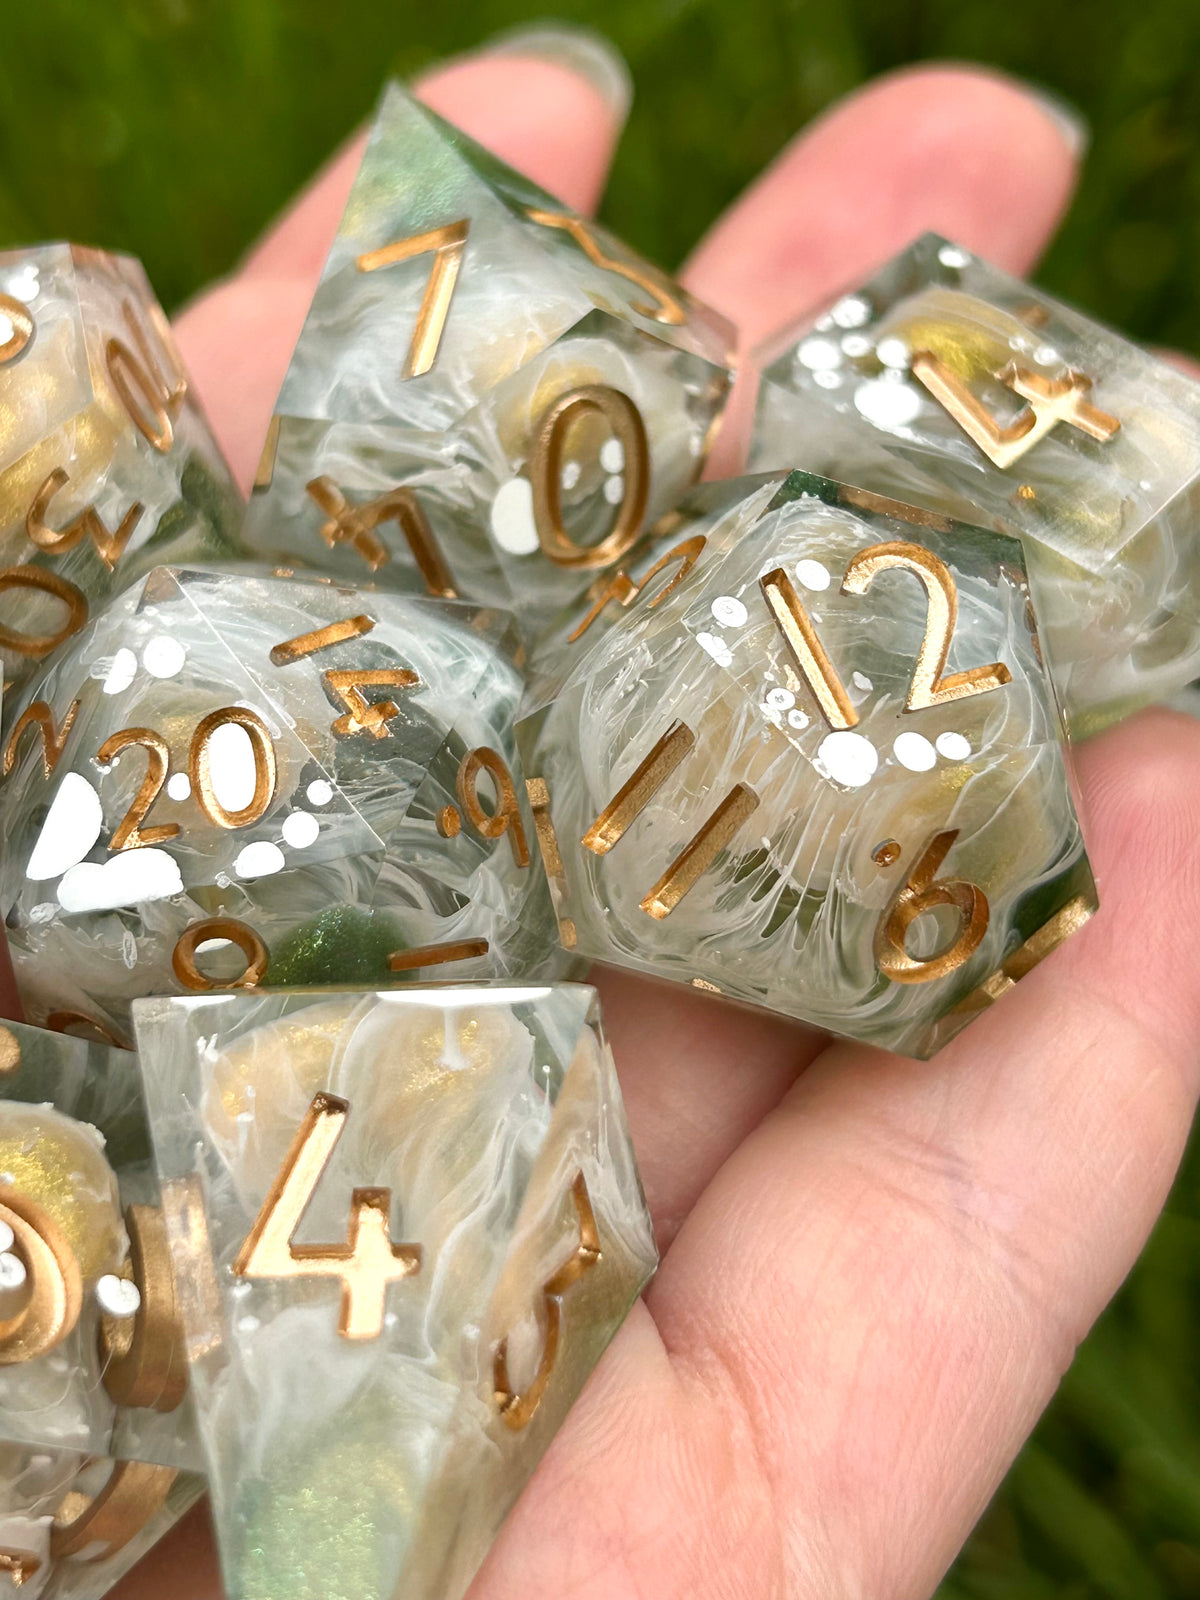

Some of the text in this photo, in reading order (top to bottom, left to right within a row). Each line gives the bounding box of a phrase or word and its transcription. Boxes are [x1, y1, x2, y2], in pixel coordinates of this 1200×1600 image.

[356, 218, 470, 381] 7
[529, 383, 650, 569] 0
[911, 350, 1121, 470] 4
[756, 540, 1013, 732] 12
[96, 706, 278, 851] 20
[580, 718, 761, 922] 11
[233, 1090, 423, 1341] 4
